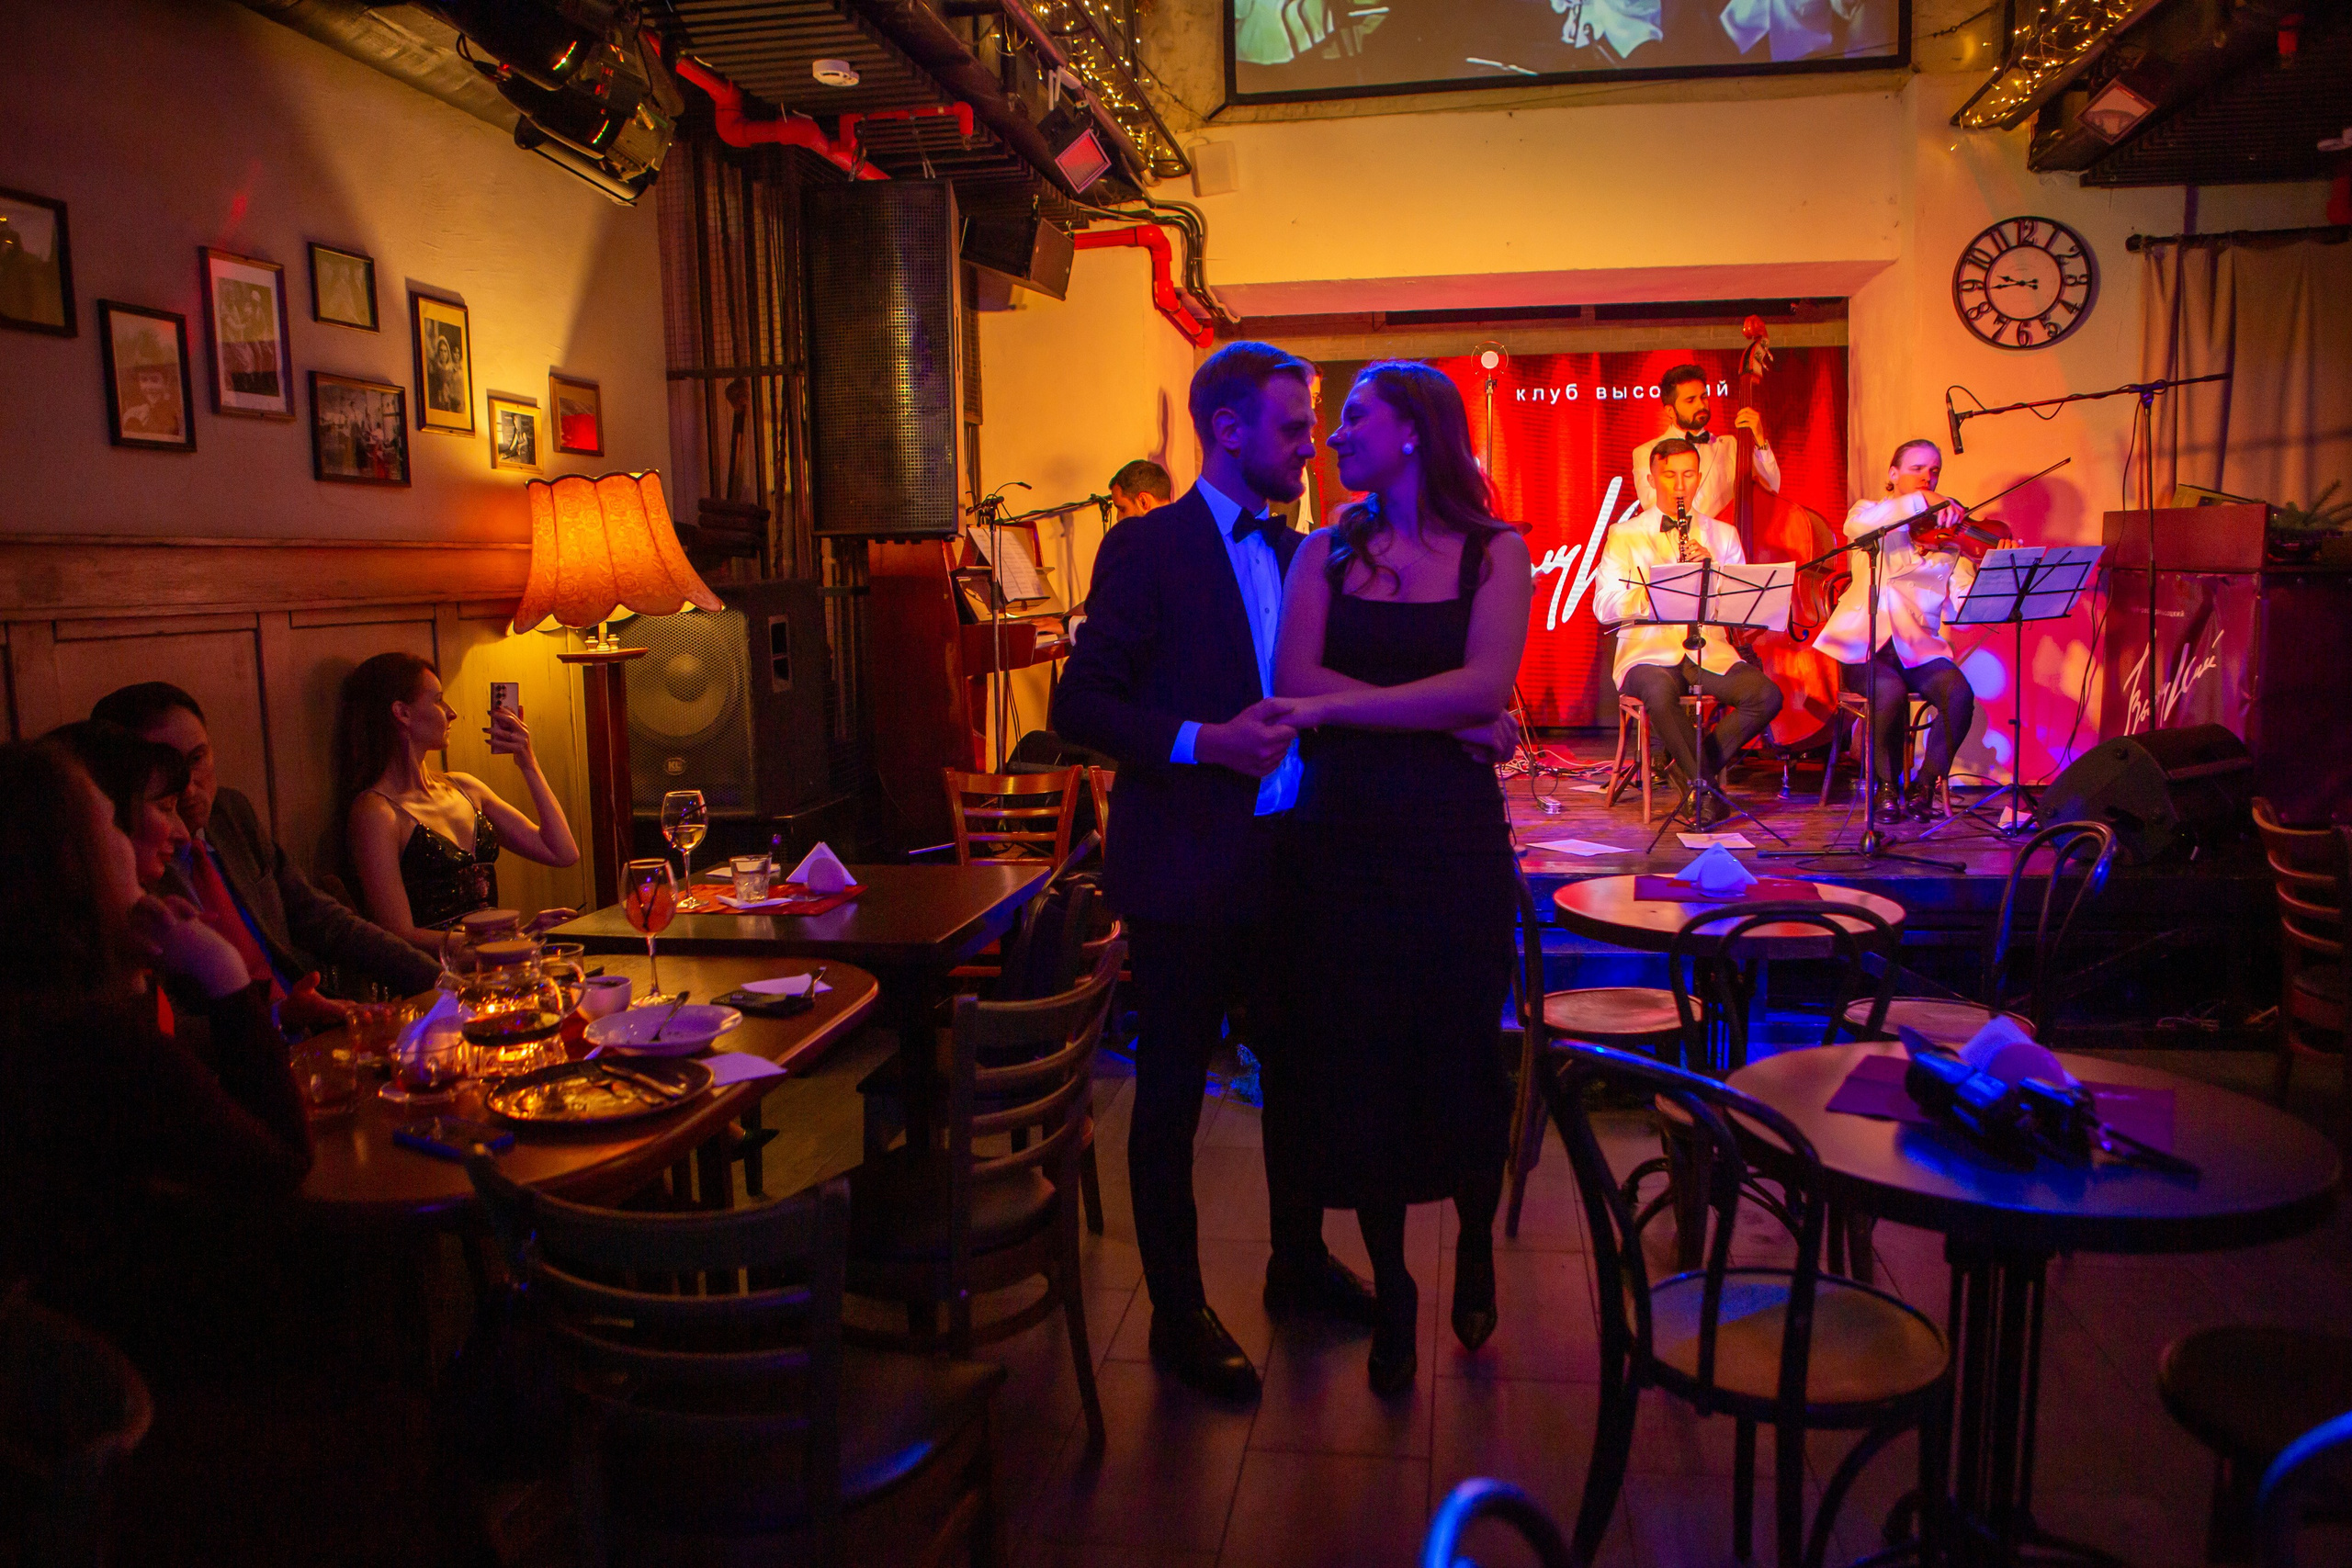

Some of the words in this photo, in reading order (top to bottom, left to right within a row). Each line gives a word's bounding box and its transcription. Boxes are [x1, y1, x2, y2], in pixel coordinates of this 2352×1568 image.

[1987, 227, 2011, 253] 11
[2015, 220, 2036, 246] 12
[1967, 247, 1994, 271] 10
[2055, 244, 2083, 266] 2
[1959, 278, 1985, 293] 9
[1966, 301, 1992, 321] 8
[2059, 299, 2082, 315] 4
[1992, 314, 2012, 343] 7
[2016, 321, 2030, 347] 6
[2038, 316, 2059, 338] 5
[1516, 383, 1578, 405] клуб
[1596, 379, 1729, 400] высой
